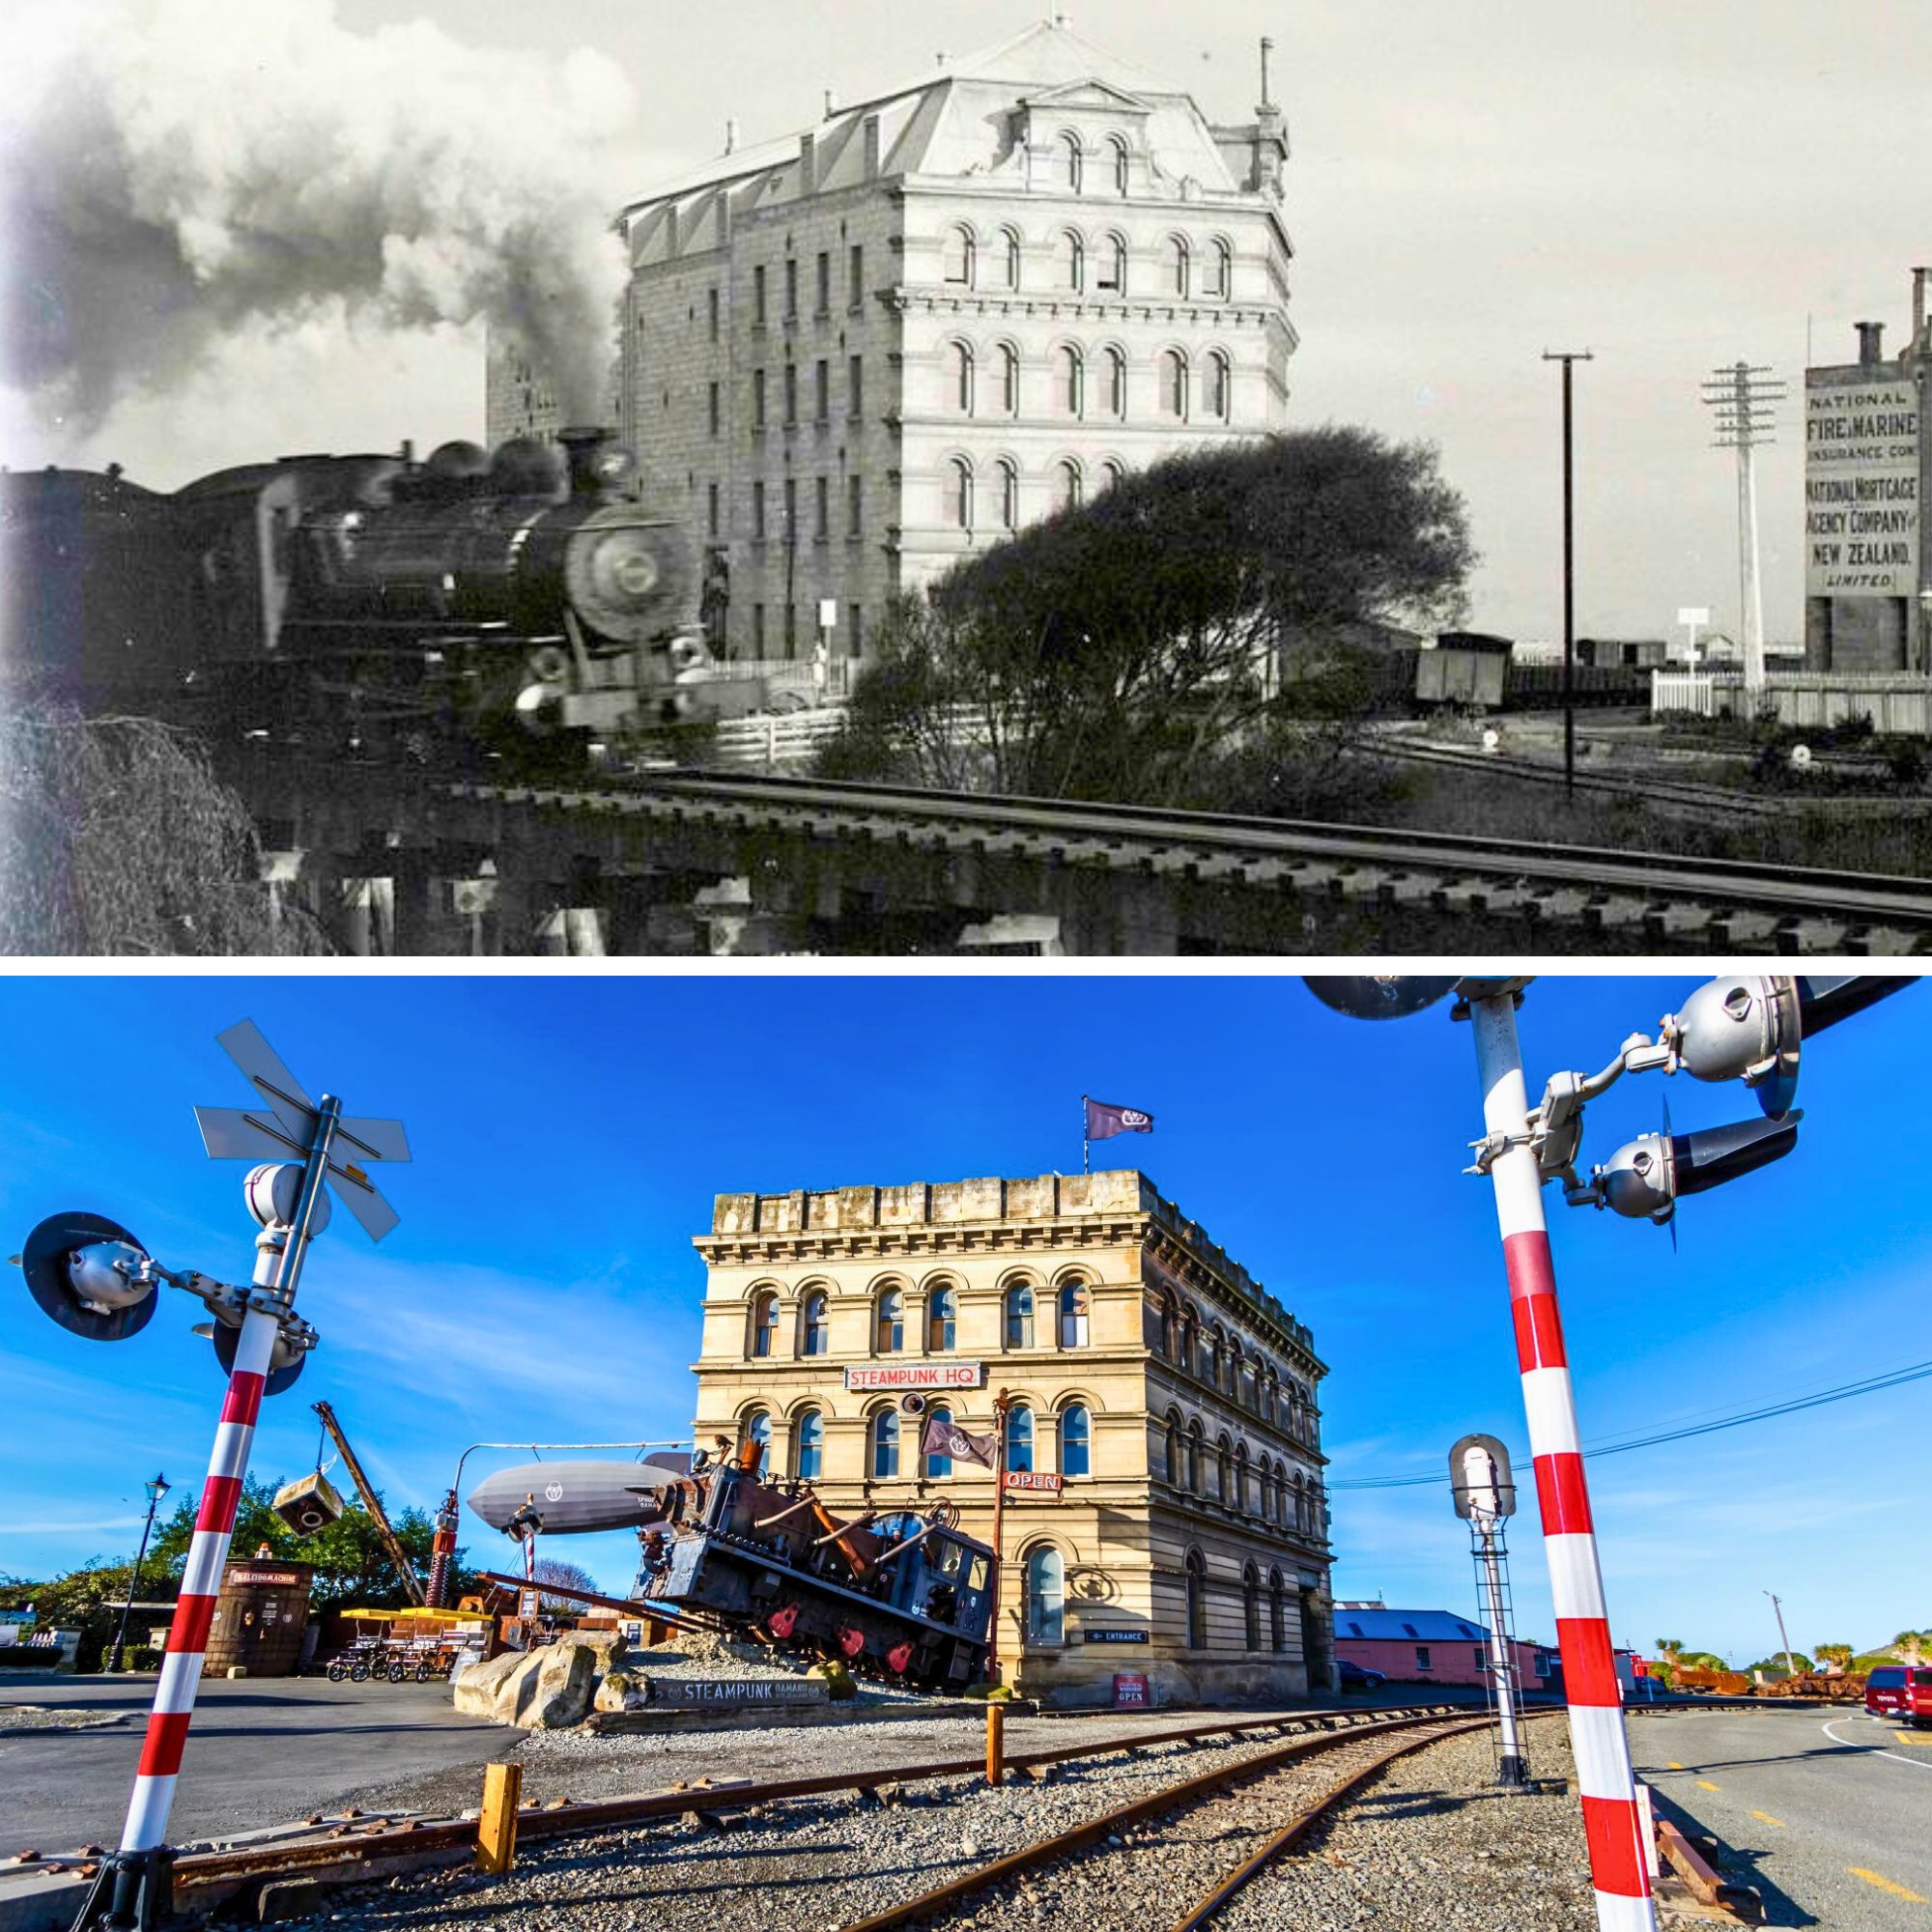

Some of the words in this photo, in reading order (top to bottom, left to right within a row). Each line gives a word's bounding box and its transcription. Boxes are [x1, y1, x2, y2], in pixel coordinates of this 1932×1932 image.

[1809, 390, 1907, 410] NATIONAL
[1807, 416, 1847, 441] FIRE
[1853, 412, 1916, 438] MARINE
[1808, 445, 1883, 461] INSURANCE
[1851, 510, 1908, 533] COMPANY
[1812, 544, 1842, 566] NEW
[851, 1367, 938, 1385] STEAMPUNK
[946, 1366, 974, 1383] HQ
[1007, 1472, 1058, 1490] OPEN
[237, 1572, 296, 1583] KALEIDOMACHINE
[684, 1683, 772, 1700] STEAMPUNK
[775, 1683, 808, 1692] OAMARU
[1119, 1692, 1143, 1701] OPEN
